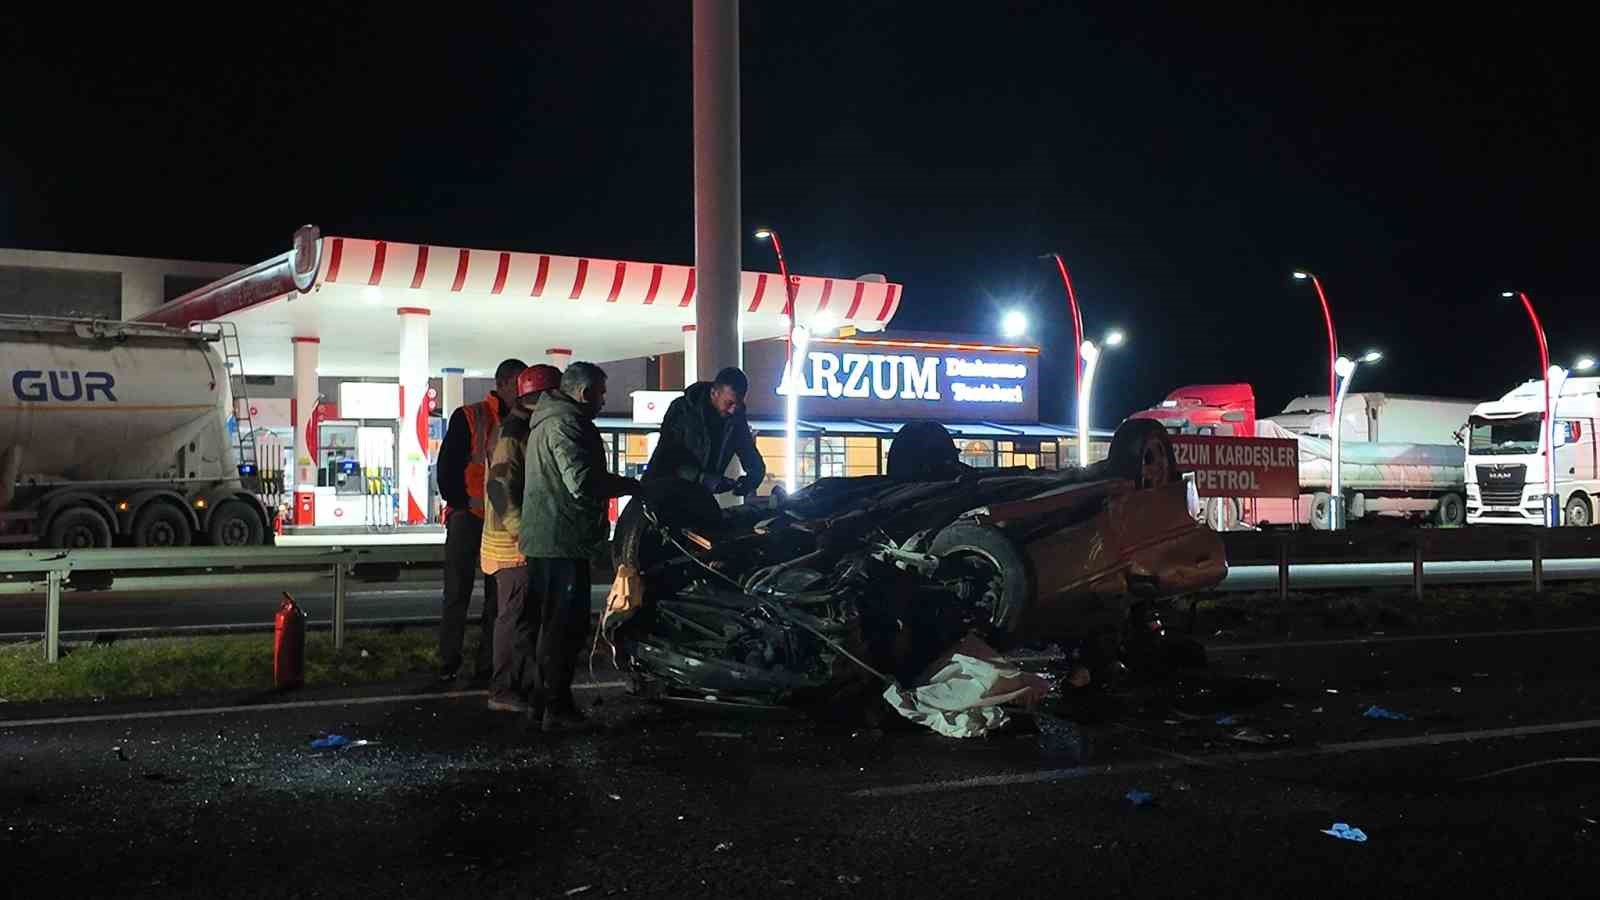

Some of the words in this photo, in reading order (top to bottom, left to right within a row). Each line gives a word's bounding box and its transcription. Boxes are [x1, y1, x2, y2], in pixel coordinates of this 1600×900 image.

[14, 373, 118, 401] GÜR
[776, 351, 941, 400] ARZUM
[1172, 442, 1210, 464] RZUM
[1215, 444, 1295, 471] KARDEŞLER
[1197, 470, 1260, 490] PETROL
